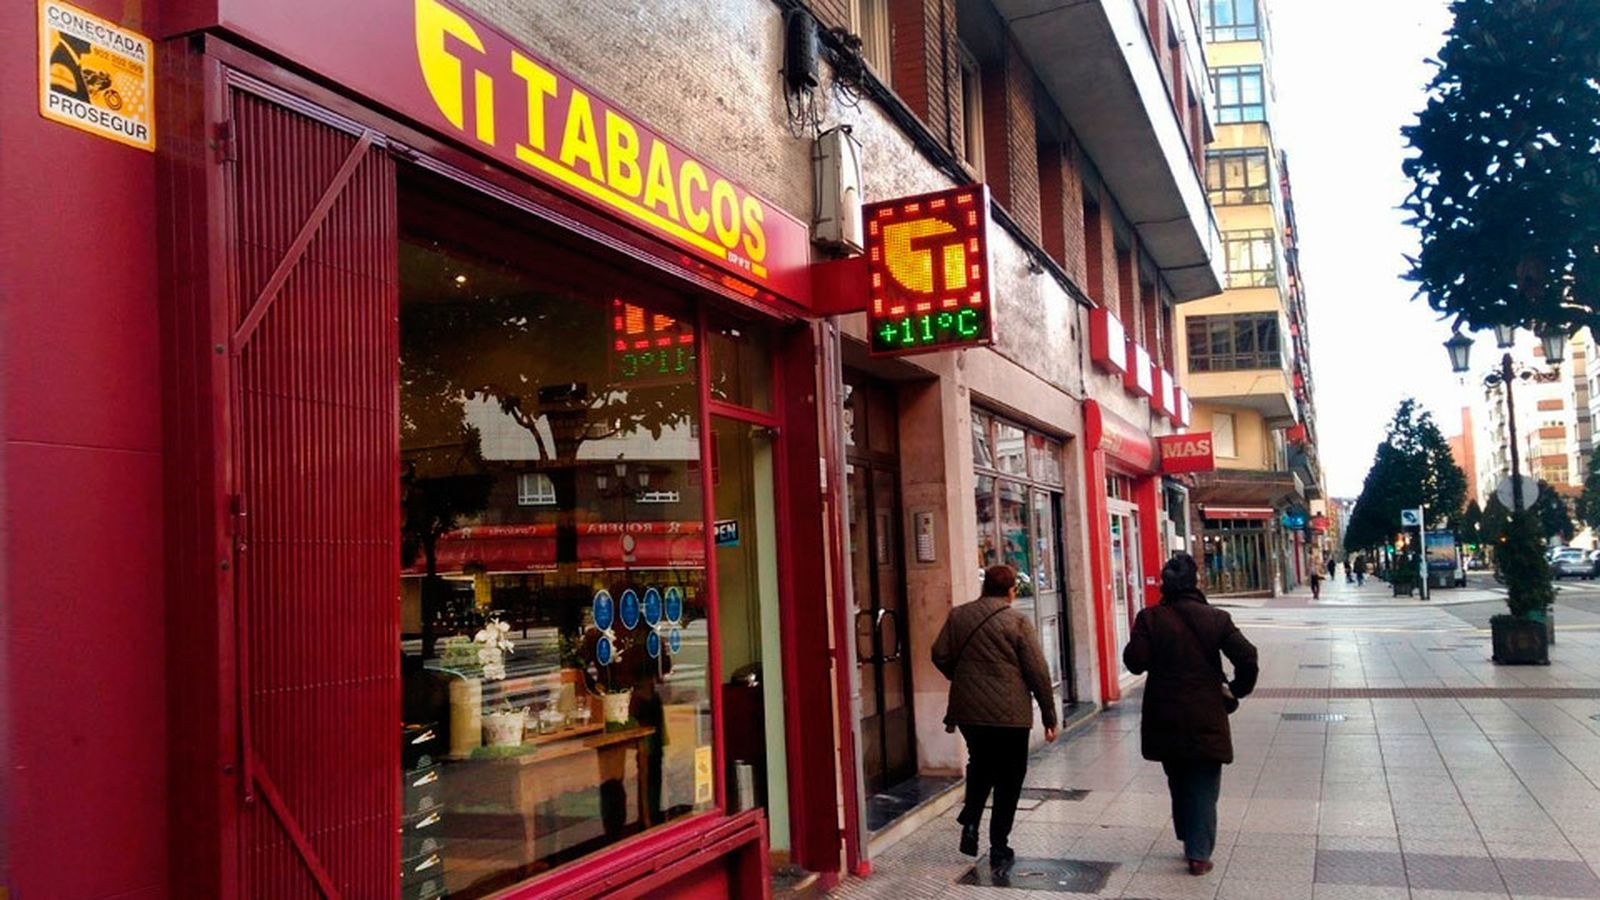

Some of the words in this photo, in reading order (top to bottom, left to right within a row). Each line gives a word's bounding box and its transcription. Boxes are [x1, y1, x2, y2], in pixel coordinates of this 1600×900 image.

[48, 6, 145, 56] CONECTADA
[49, 94, 147, 141] PROSEGUR
[512, 51, 767, 263] TABACOS
[1162, 439, 1210, 458] MAS
